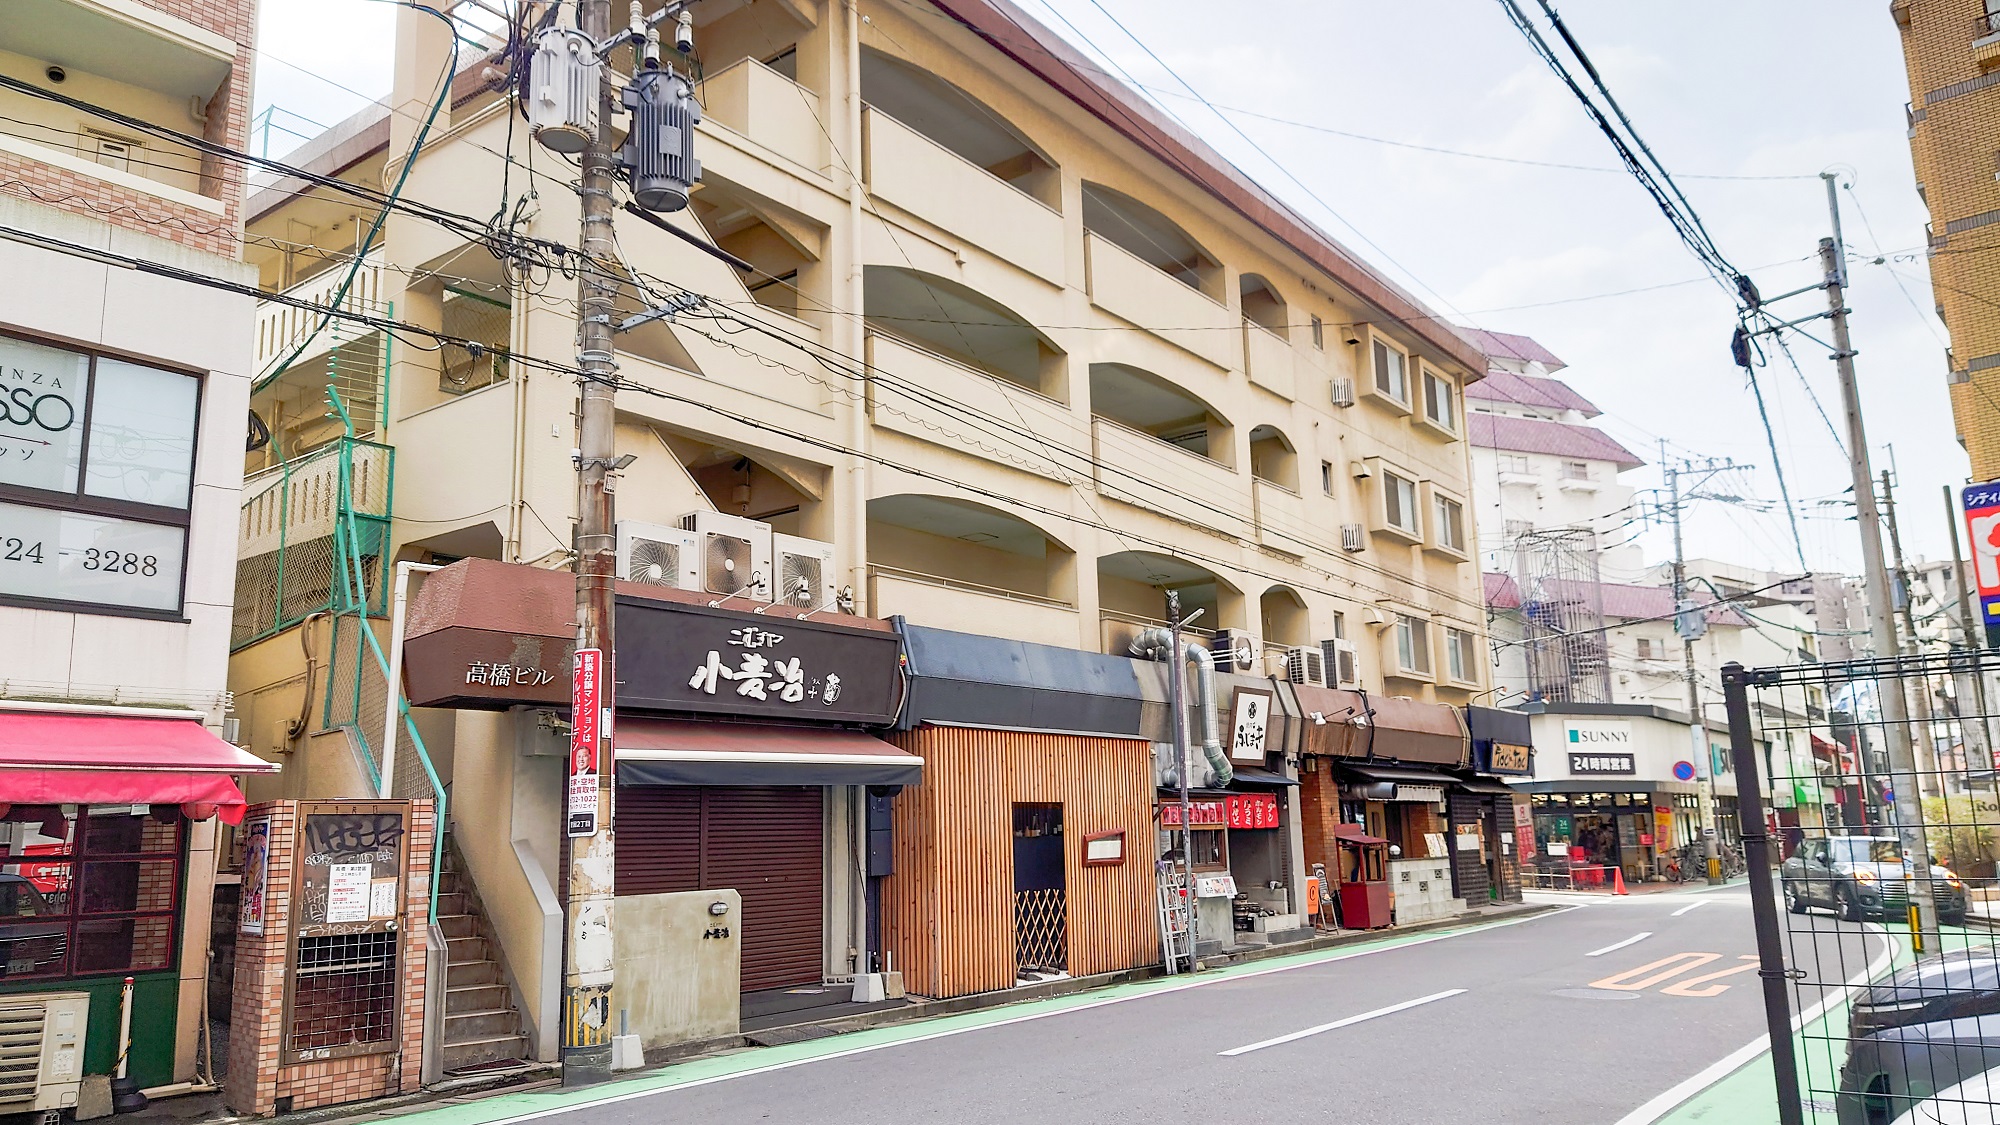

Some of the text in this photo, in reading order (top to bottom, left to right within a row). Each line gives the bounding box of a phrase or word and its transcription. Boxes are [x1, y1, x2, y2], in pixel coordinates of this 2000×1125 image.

[0, 537, 44, 564] 24
[83, 547, 157, 577] 3288
[465, 660, 555, 687] 高橋ビル
[1581, 731, 1629, 743] SUNNY
[1573, 757, 1632, 770] 24時間営業
